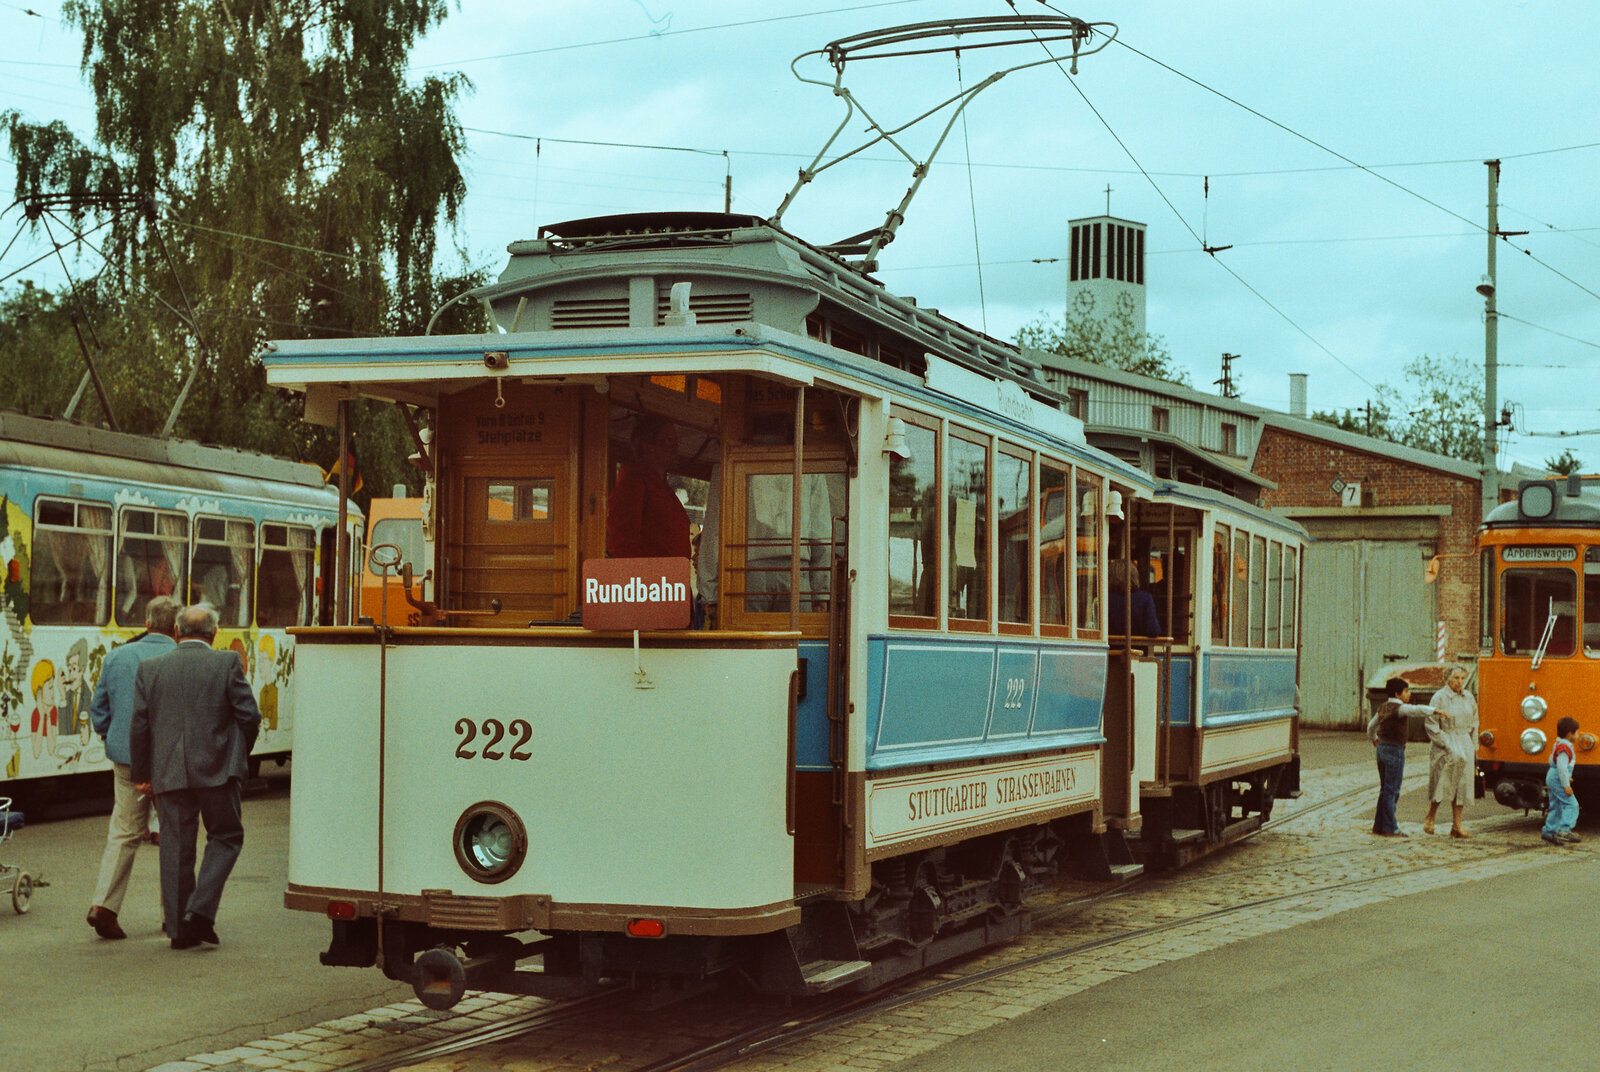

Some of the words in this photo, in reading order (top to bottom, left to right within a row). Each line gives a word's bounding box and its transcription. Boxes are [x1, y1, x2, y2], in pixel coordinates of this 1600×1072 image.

[1346, 486, 1357, 502] 7
[1506, 547, 1575, 561] Arbeitswagen
[586, 576, 686, 604] Rundbahn
[1004, 678, 1025, 709] 222
[454, 717, 533, 761] 222
[908, 781, 987, 822] STUTTGARTER
[996, 767, 1077, 804] STRASSENBAHNEN
